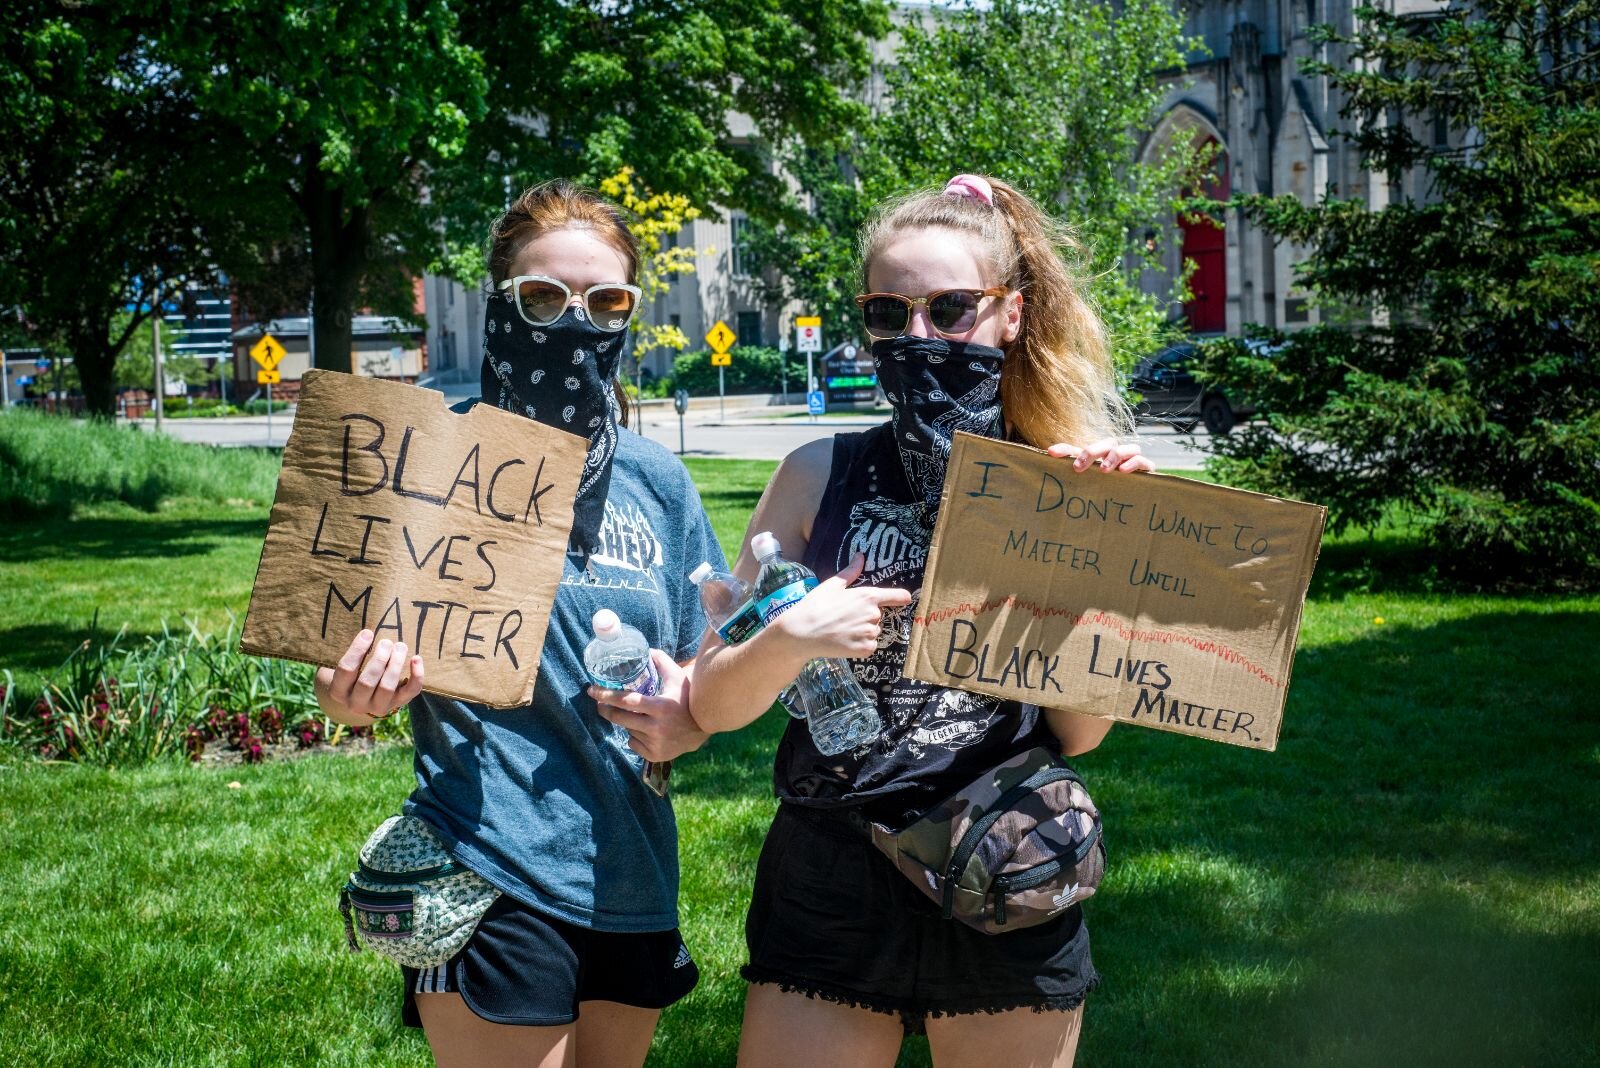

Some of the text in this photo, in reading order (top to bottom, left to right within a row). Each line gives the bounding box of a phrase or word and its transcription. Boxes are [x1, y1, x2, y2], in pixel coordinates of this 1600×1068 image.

[340, 413, 555, 527] BLACK
[966, 461, 1268, 556] I DON'T WANT TO
[310, 502, 497, 591] LIVES
[565, 574, 643, 590] GAZINE
[870, 557, 924, 586] AMERICAN
[1003, 529, 1196, 598] MATTER UNTIL
[321, 581, 523, 670] MATTER
[944, 619, 1172, 694] BLACK LIVES
[928, 724, 960, 743] LEGEND
[1131, 688, 1261, 743] MATTER.
